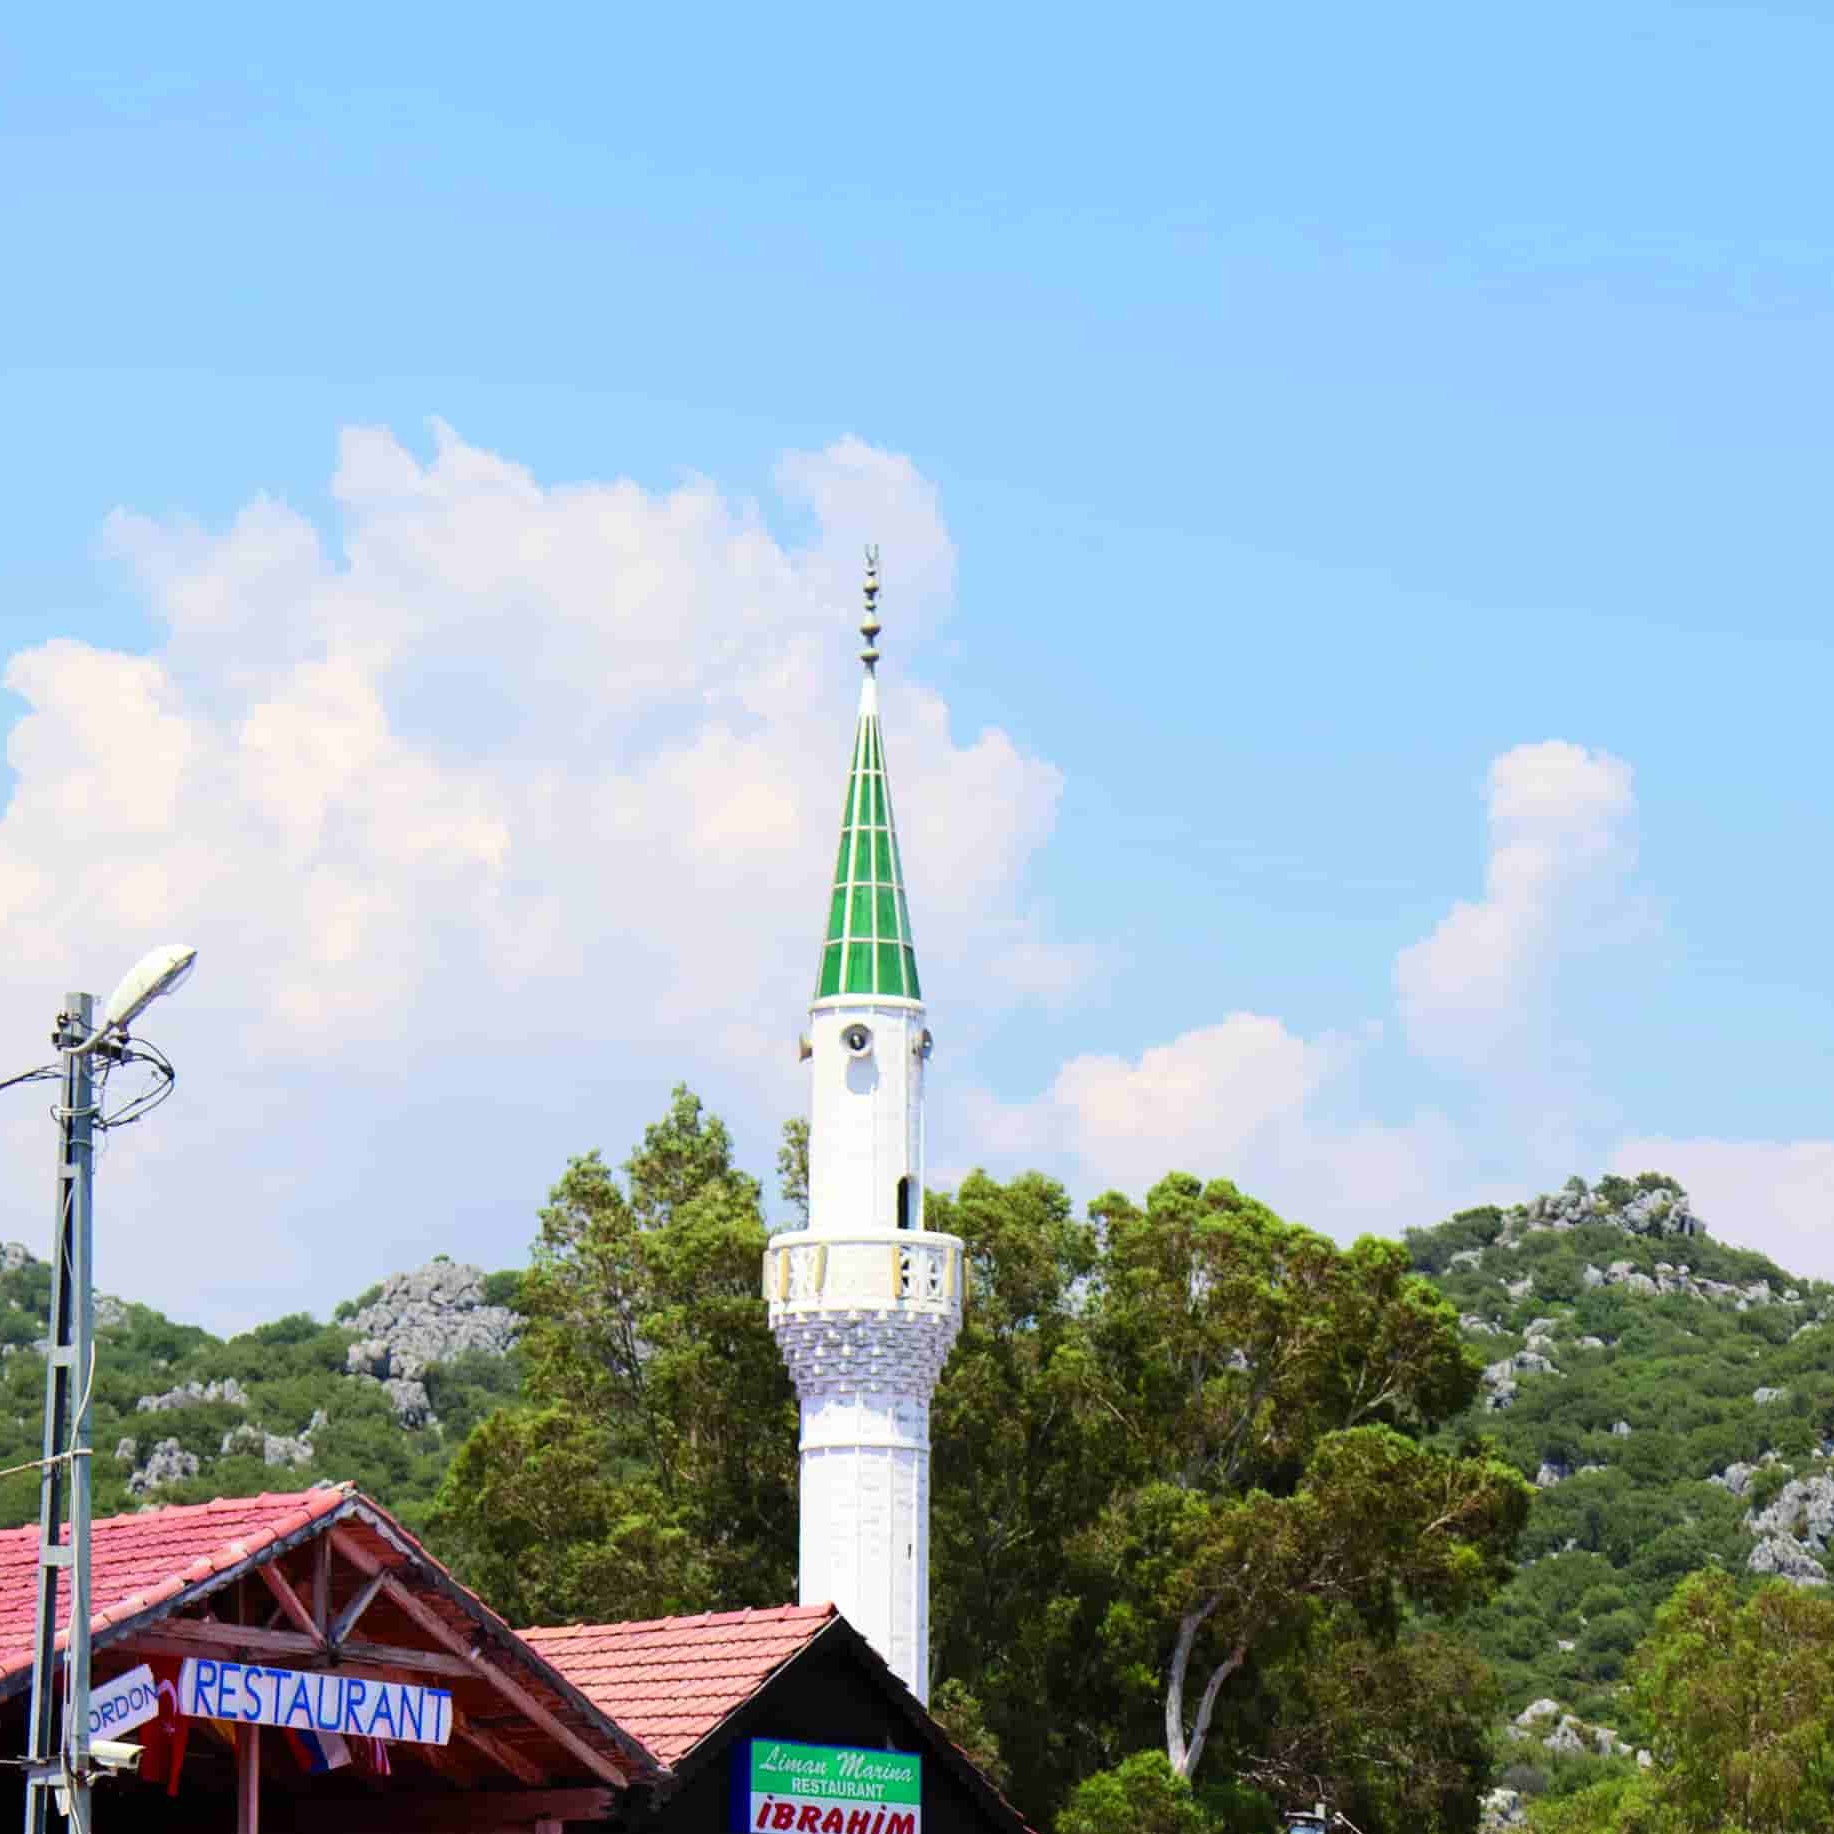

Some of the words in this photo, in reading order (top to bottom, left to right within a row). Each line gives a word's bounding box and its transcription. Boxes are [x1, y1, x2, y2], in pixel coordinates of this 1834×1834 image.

[86, 1681, 160, 1733] ORDON
[193, 1659, 452, 1743] RESTAURANT
[759, 1745, 828, 1775] Liman
[836, 1751, 914, 1783] Marina
[792, 1777, 885, 1800] RESTAURANT
